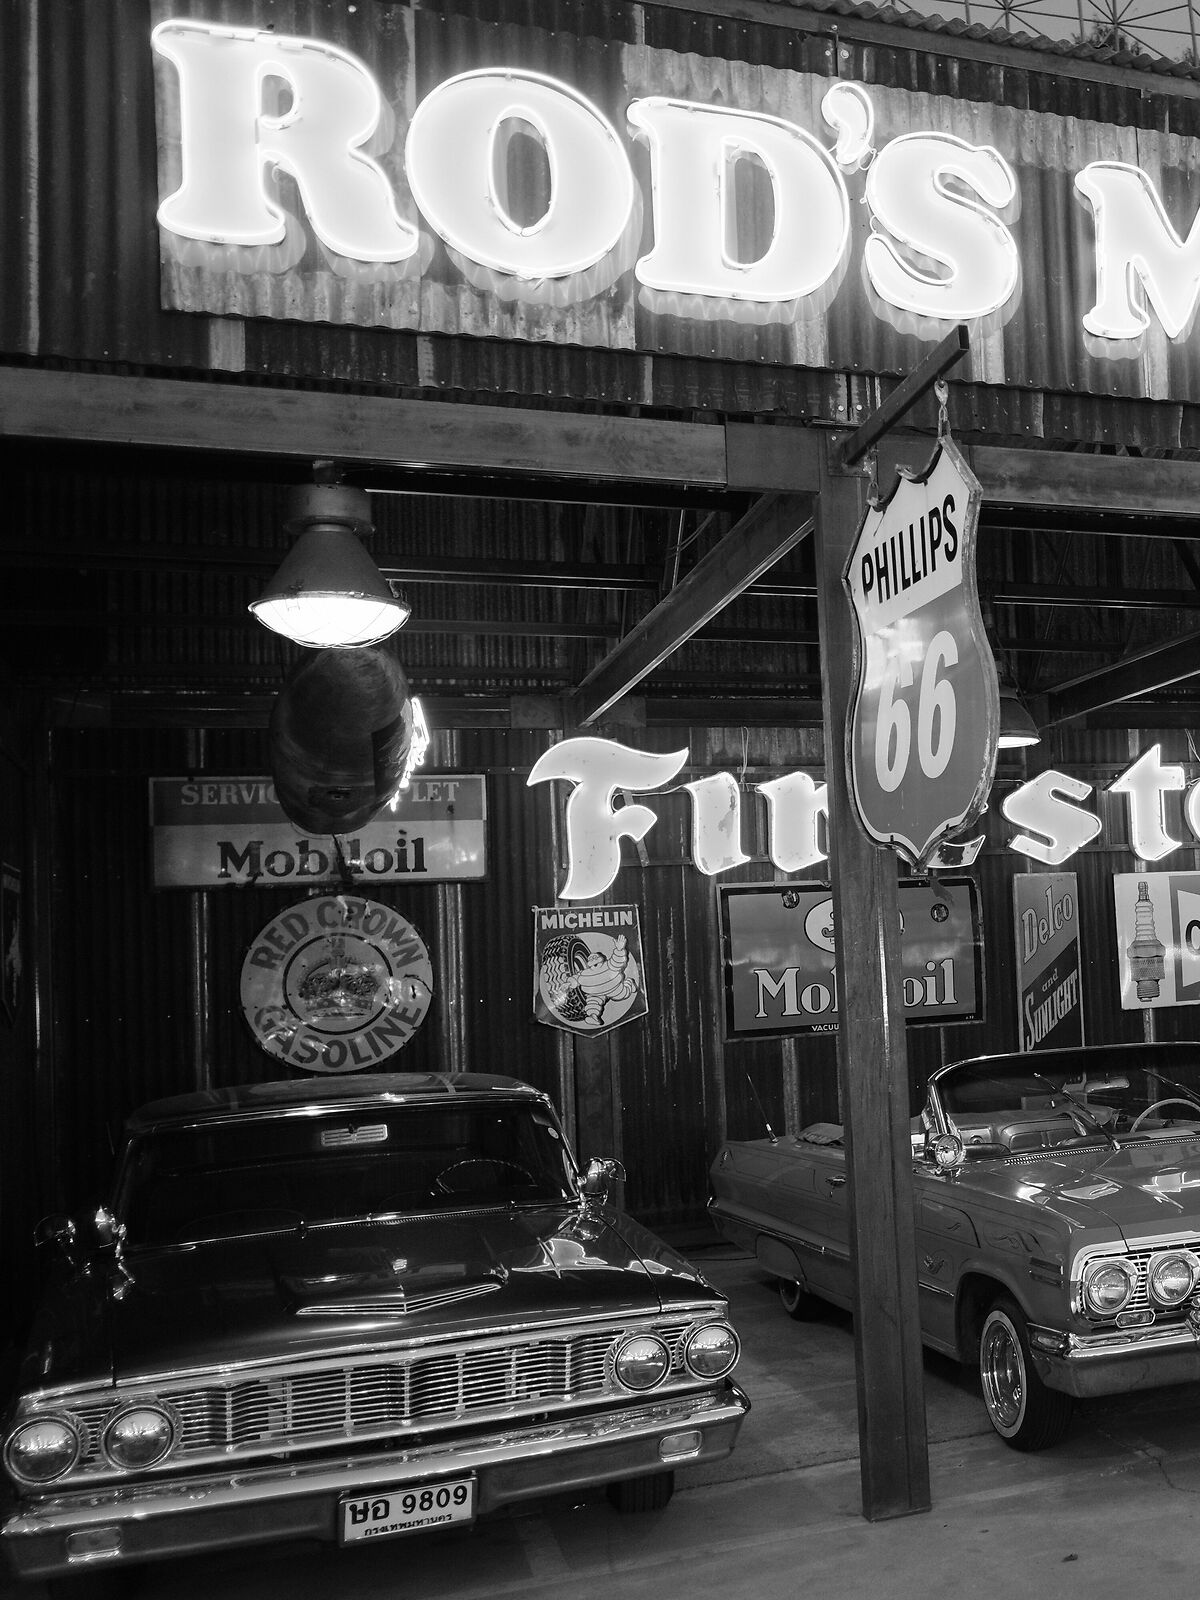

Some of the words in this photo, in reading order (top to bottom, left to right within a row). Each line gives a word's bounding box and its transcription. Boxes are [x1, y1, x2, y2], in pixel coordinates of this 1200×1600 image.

[152, 19, 1020, 319] ROD'S
[861, 493, 959, 604] PHILLIPS
[874, 630, 959, 793] 66
[250, 913, 309, 970] RED
[316, 900, 424, 968] CROWN
[541, 910, 633, 930] MICHELIN
[1022, 885, 1074, 965] Delco
[1024, 967, 1079, 1050] SUNLIGHT
[1042, 967, 1059, 994] and
[254, 1004, 422, 1068] GASOLINE
[811, 1023, 840, 1032] VACUU
[402, 1485, 468, 1514] 9809
